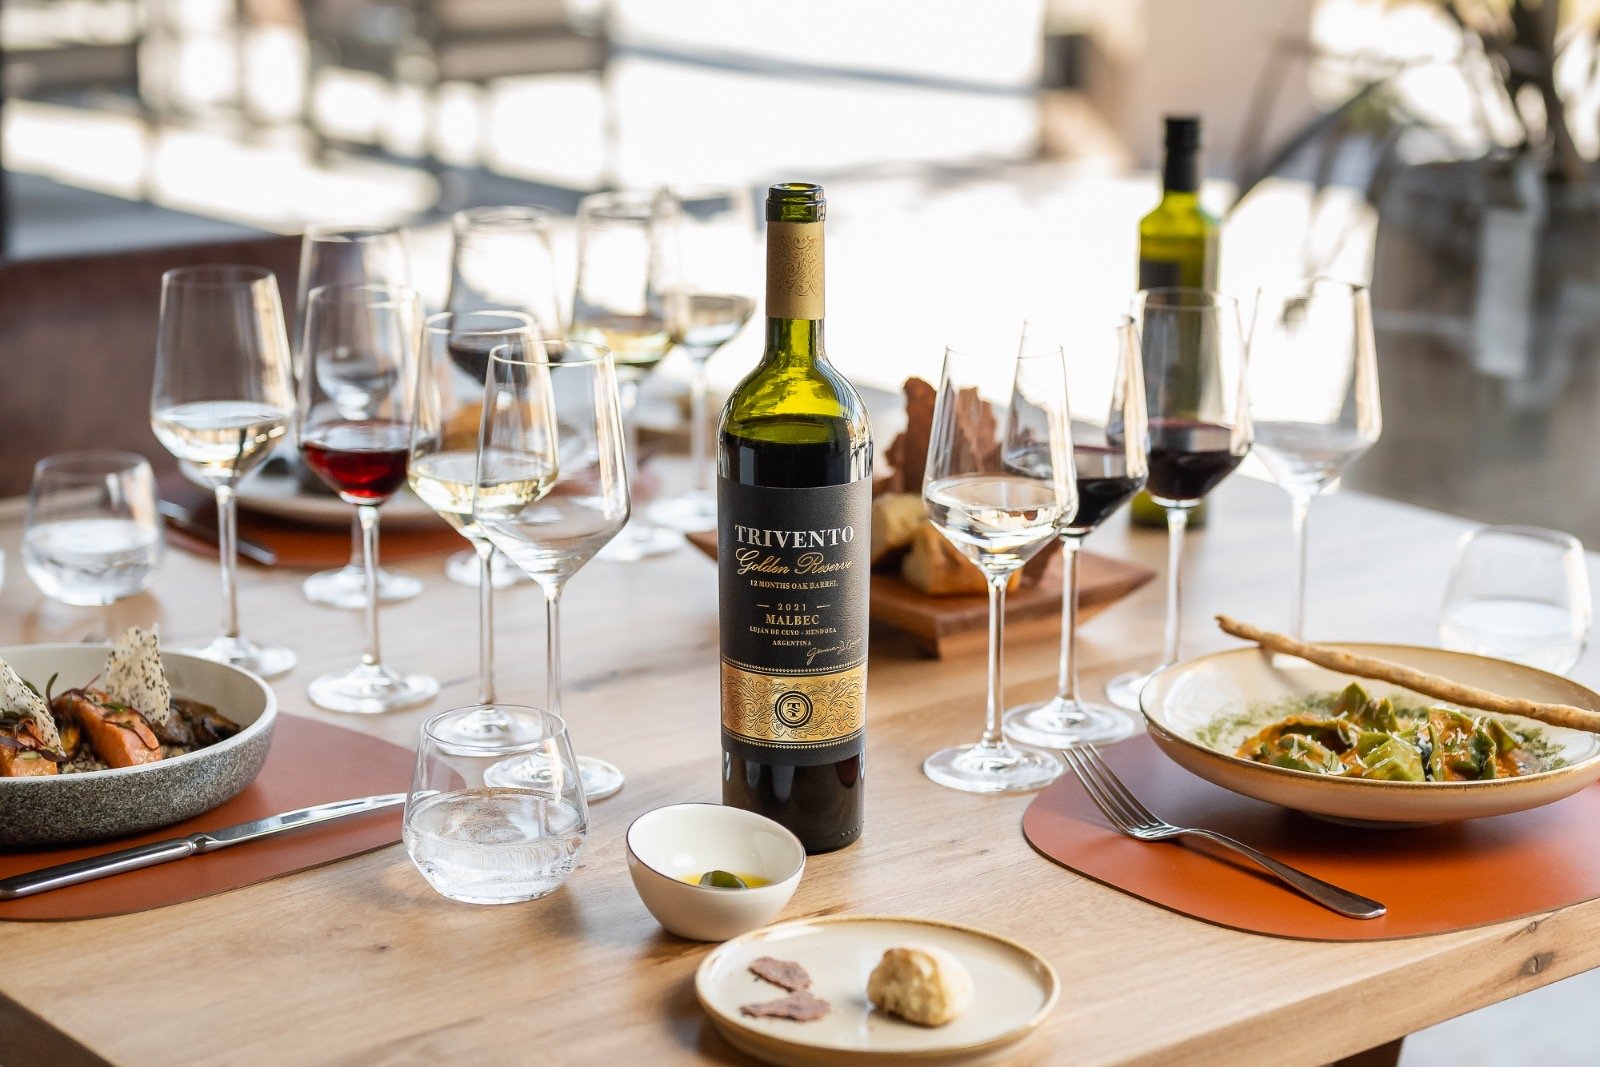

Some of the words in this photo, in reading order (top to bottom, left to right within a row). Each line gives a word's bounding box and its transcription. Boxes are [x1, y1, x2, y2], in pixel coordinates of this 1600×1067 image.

[735, 524, 854, 548] TRIVENTO
[736, 548, 790, 574] Golden
[795, 552, 853, 575] Reserve
[759, 581, 790, 589] MONTHS
[765, 614, 820, 625] MALBEC
[750, 626, 769, 634] LUJÁN
